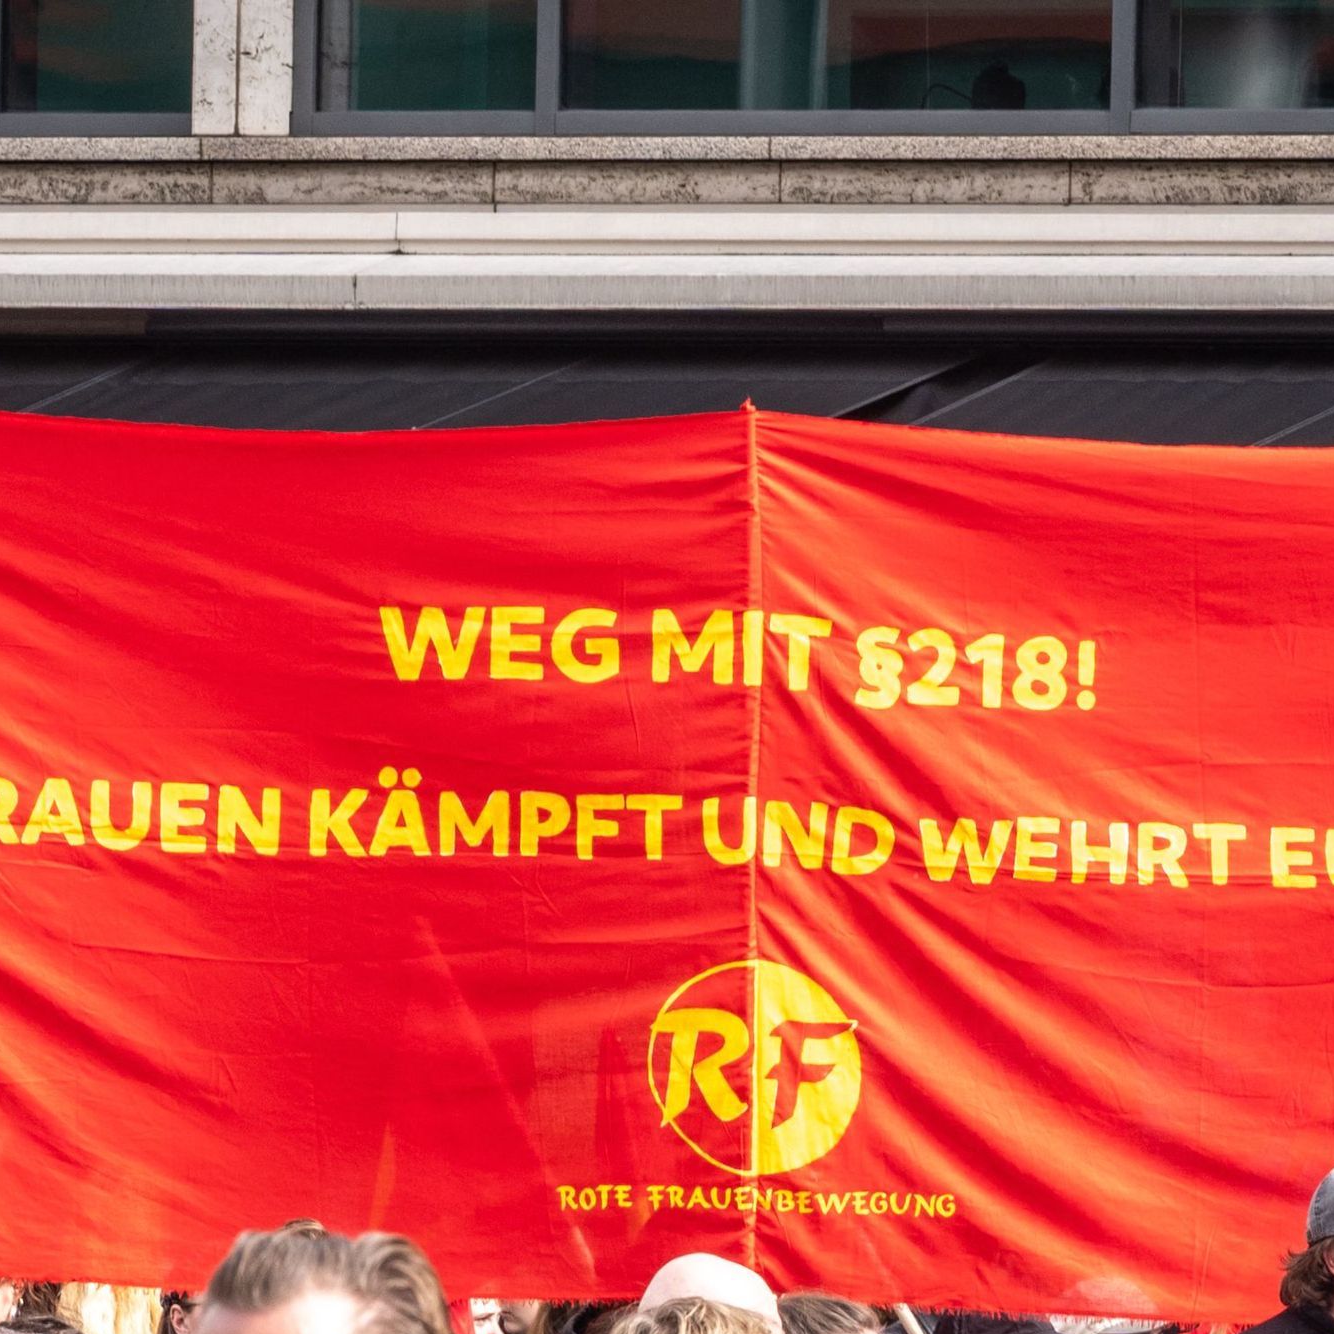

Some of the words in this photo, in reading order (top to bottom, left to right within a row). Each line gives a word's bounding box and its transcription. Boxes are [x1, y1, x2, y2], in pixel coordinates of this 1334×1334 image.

[379, 606, 620, 683] WEG
[651, 608, 833, 691] MIT
[854, 625, 1096, 713] §218!
[309, 766, 683, 861] KÄMPFT
[702, 796, 896, 876] UND
[919, 815, 1246, 889] WEHRT
[556, 1184, 633, 1212] ROTE
[647, 1185, 956, 1218] FRAUENBEWEGUNG
